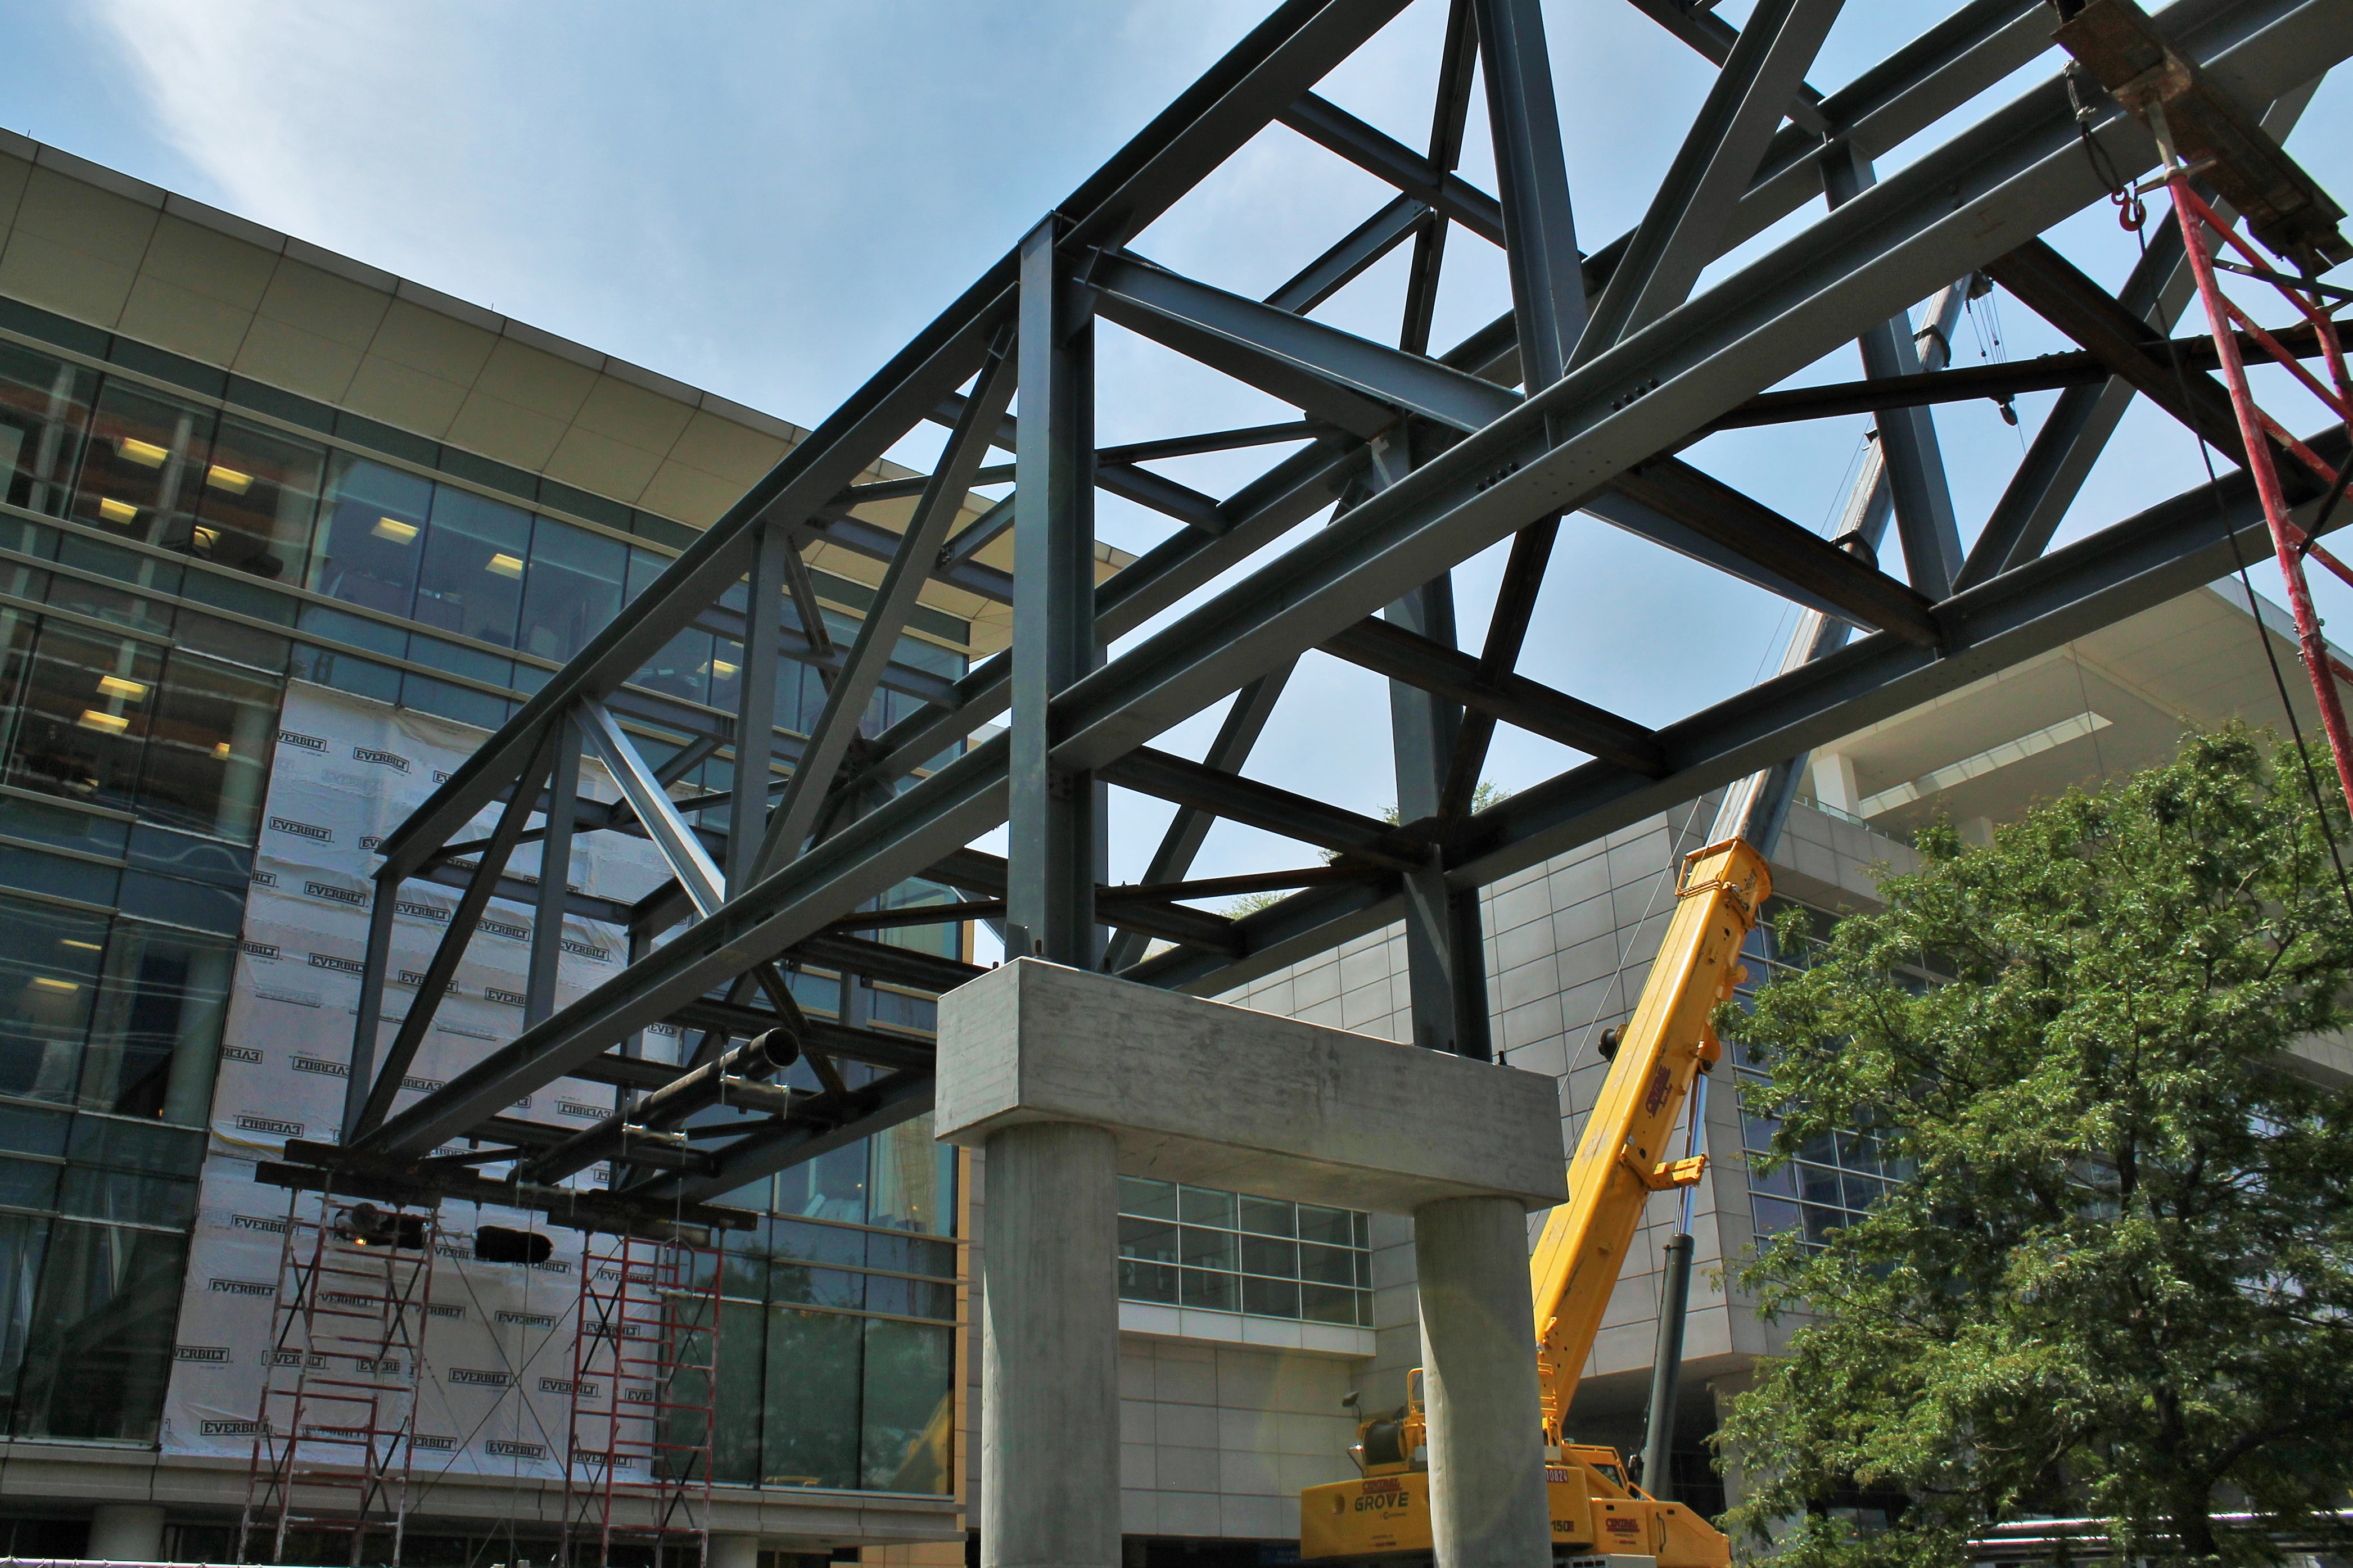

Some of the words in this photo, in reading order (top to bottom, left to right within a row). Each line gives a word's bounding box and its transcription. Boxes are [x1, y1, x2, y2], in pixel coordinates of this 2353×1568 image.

[277, 731, 324, 750] VERBILT
[356, 749, 407, 770] EVERBILT
[272, 819, 329, 839] EVERBILT
[307, 884, 363, 903] EVERBILT
[395, 903, 448, 920] EVERBILT
[478, 921, 528, 939] EVERBILT
[243, 944, 277, 957] RBILT
[560, 941, 607, 959] EVERBILT
[488, 989, 525, 1005] EVERB
[225, 1048, 261, 1061] EVER
[403, 1078, 443, 1091] EVERB
[562, 1103, 612, 1119] EVERBILT
[241, 1118, 301, 1136] EVERBILT
[234, 1217, 296, 1235] EVERBIT
[211, 1280, 276, 1296] EVERBILT
[498, 1313, 553, 1328] EVERBILT
[174, 1349, 226, 1361] VERBILT
[451, 1370, 509, 1386] EVERBILT
[542, 1380, 596, 1394] EVERILT
[413, 1437, 454, 1449] ERBILT
[489, 1442, 543, 1457] EVERBILT
[1354, 1492, 1409, 1511] GROVE
